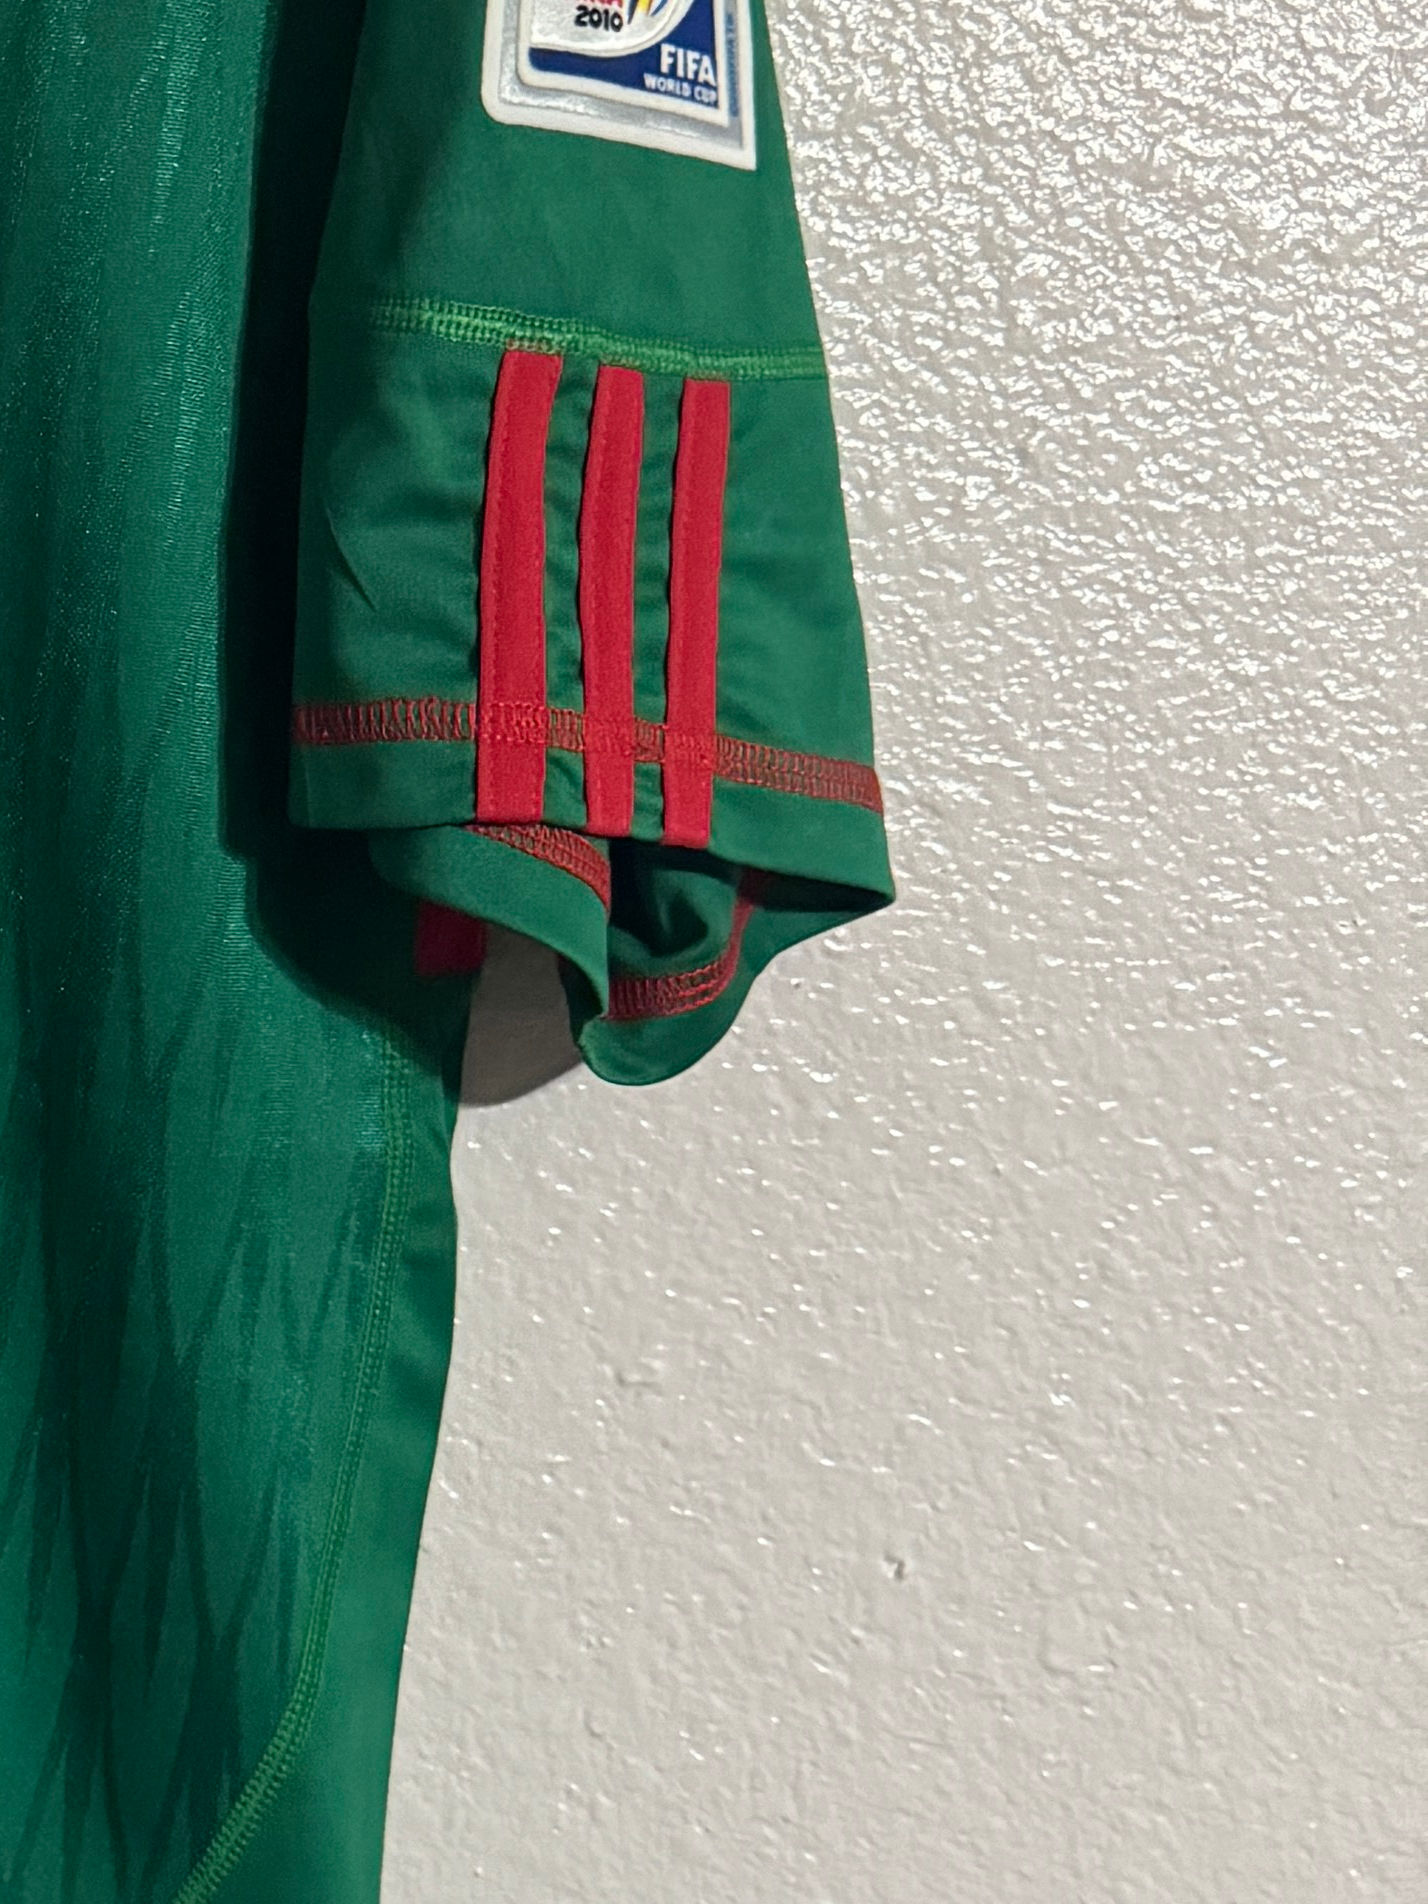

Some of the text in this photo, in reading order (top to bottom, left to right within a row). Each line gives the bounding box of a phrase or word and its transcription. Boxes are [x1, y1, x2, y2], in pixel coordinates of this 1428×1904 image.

[574, 5, 624, 33] 2010
[660, 43, 717, 87] FIFA
[643, 72, 692, 97] WORLD
